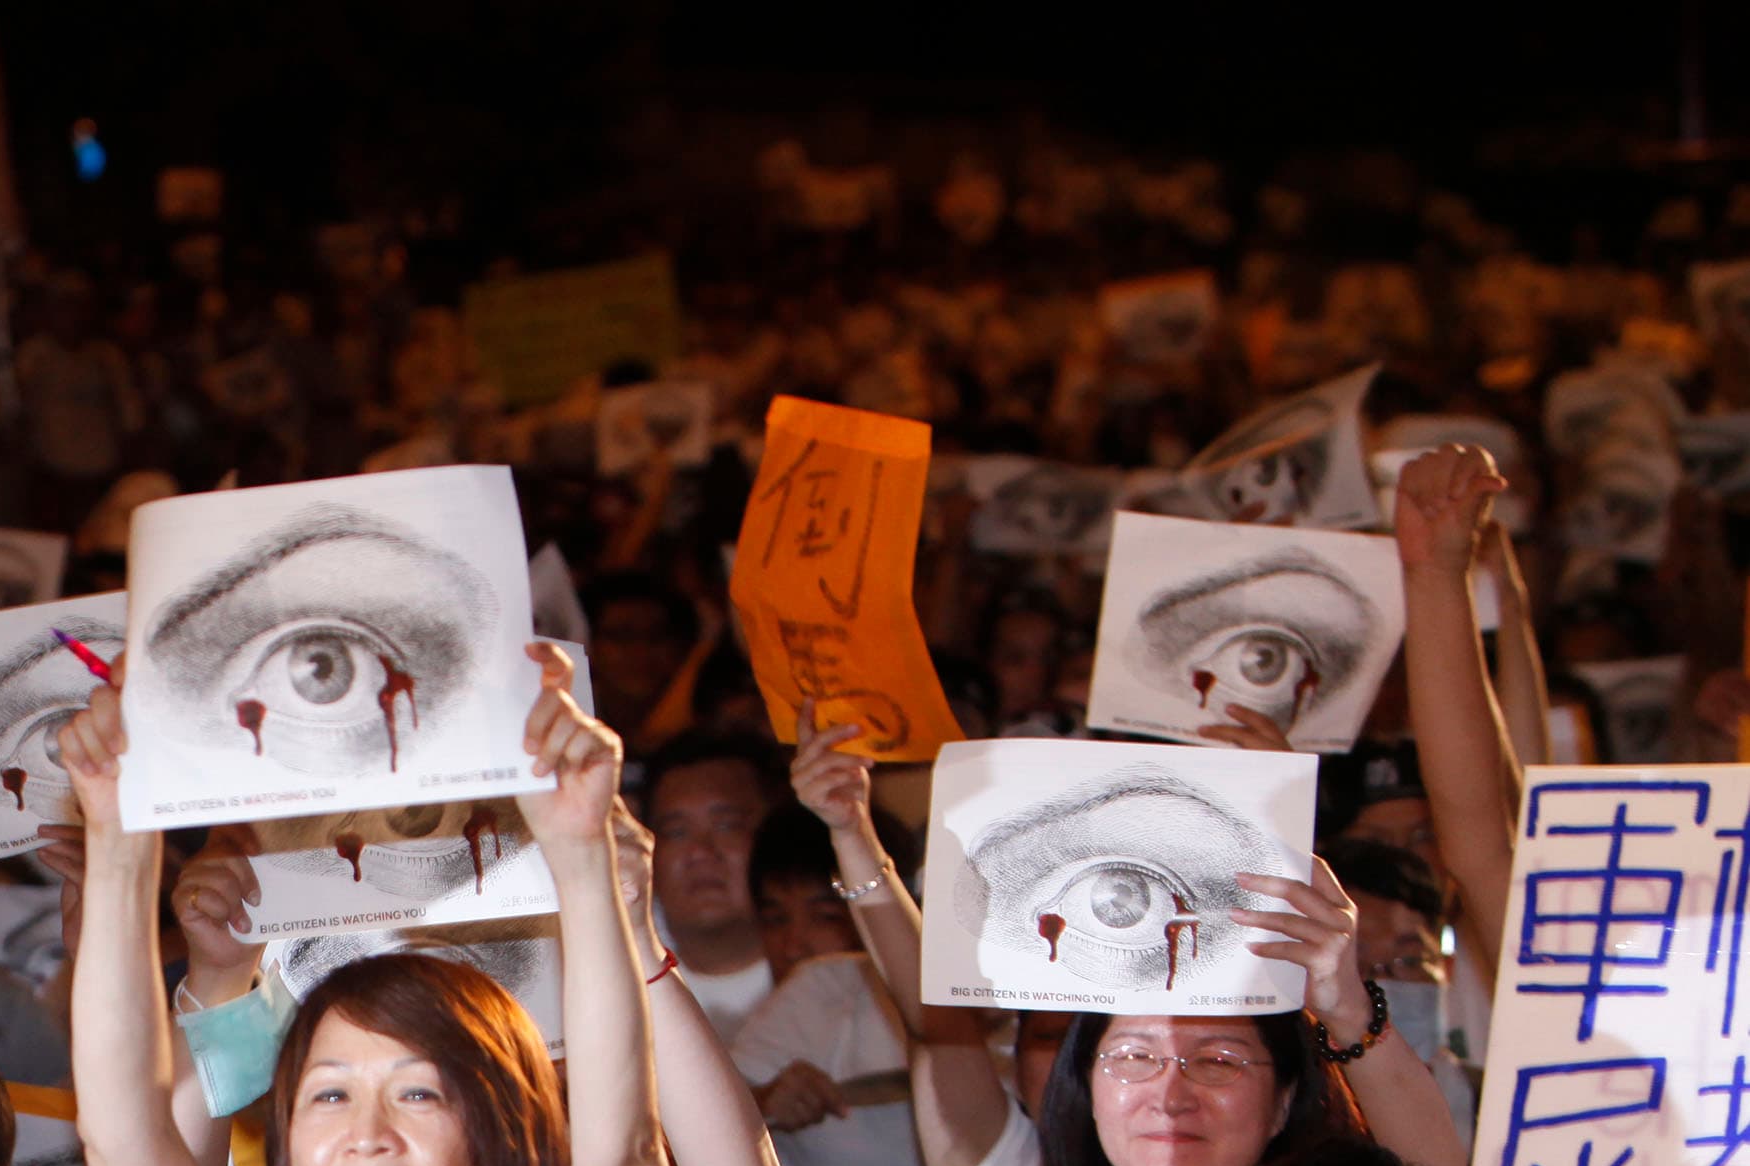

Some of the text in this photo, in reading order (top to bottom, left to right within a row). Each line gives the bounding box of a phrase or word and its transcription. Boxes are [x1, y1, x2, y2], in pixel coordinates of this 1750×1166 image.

[153, 803, 176, 814] BIG
[0, 841, 9, 849] IS
[260, 907, 428, 934] BIG CITIZEN IS WATCHING YOU
[951, 987, 1117, 1005] BIG CITIZEN IS WATCHING YOU
